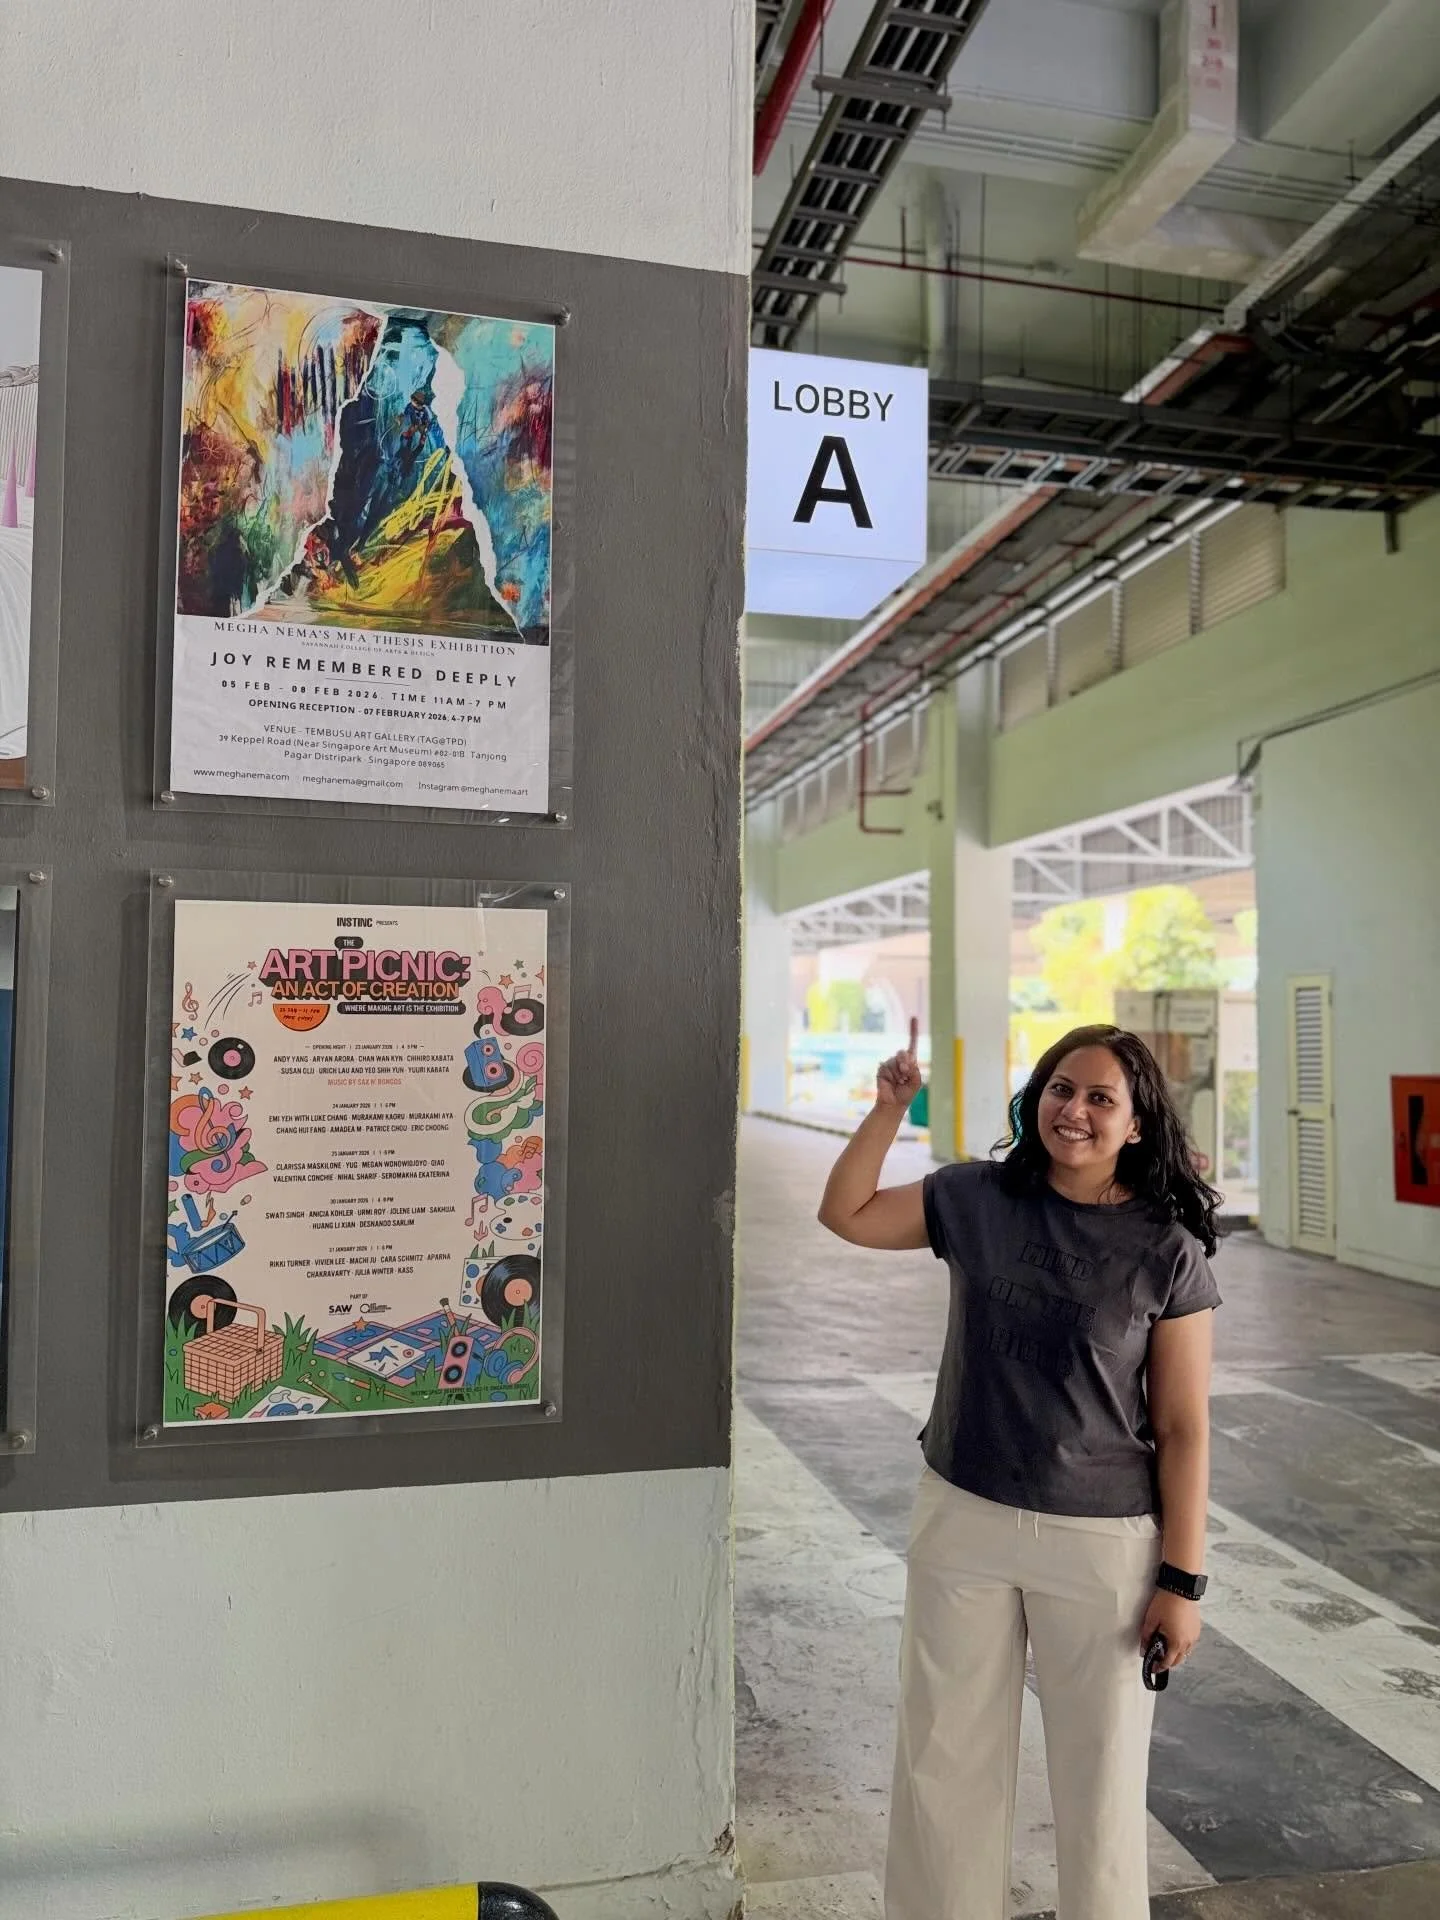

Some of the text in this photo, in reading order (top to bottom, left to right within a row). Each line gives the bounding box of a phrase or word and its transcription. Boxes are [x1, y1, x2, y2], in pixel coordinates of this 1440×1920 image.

[774, 380, 894, 423] LOBBY
[792, 434, 874, 530] A
[214, 621, 516, 656] MEGHA NEMA'S MFA THESIS EXHIBITION
[210, 650, 517, 688] JOY REMEMBERED DEEPLY
[222, 679, 236, 689] 05
[245, 681, 270, 691] FEB
[292, 684, 306, 694] 08
[315, 686, 340, 696] FEB
[392, 692, 426, 703] TIME
[488, 700, 506, 710] PM
[249, 698, 297, 710] OPENING
[299, 702, 355, 715] RECEPTION
[364, 707, 374, 716] 07
[376, 708, 426, 720] FEBRUARY
[467, 715, 481, 724] PM
[264, 724, 297, 735] VENUE
[305, 727, 352, 739] TEMBUSU
[354, 730, 372, 740] ART
[374, 731, 415, 744] GALLERY
[231, 734, 265, 746] Keppel
[267, 736, 291, 747] Road
[293, 738, 320, 749] (Near
[322, 740, 371, 753] Singapore
[373, 744, 387, 753] Art
[471, 751, 507, 763] Tanjong
[284, 750, 312, 761] Pagar
[315, 752, 362, 764] Distripark
[368, 755, 416, 768] Singapore
[418, 782, 459, 793] Instagram
[461, 785, 528, 796] @meghanemaart
[337, 916, 373, 928] INSTINC
[343, 939, 355, 947] THE
[259, 948, 472, 986] ART PICNIC:
[271, 981, 459, 999] AN ACT OF CREATION
[345, 1004, 459, 1013] WHERE MAKING ART IS THE EXHIBITION
[273, 1055, 290, 1063] ANDY
[292, 1055, 309, 1063] YANG
[312, 1055, 333, 1063] ARYAN
[334, 1055, 354, 1063] ARORA
[280, 1067, 301, 1075] SUSAN
[364, 1066, 376, 1074] YEO
[392, 1066, 404, 1074] YUN
[269, 1115, 280, 1123] EMI
[294, 1114, 309, 1122] WITH
[311, 1114, 326, 1122] LUKE
[327, 1114, 348, 1122] CHANG
[351, 1113, 384, 1121] MURAKAMI
[408, 1112, 440, 1120] MURAKAMI
[442, 1112, 454, 1120] AYA
[276, 1126, 297, 1135] CHANG
[309, 1126, 326, 1134] FANG
[330, 1125, 355, 1133] AMADEA
[356, 1125, 362, 1133] M
[365, 1125, 390, 1133] PATRICE
[411, 1124, 424, 1132] ERIC
[276, 1163, 306, 1171] CLARISSA
[273, 1174, 306, 1183] VALENTINA
[337, 1173, 354, 1181] NIHAL
[419, 1170, 450, 1179] EKATERINA
[265, 1212, 284, 1220] SWATI
[286, 1211, 305, 1219] SINGH
[330, 1209, 354, 1217] KOHLER
[412, 1206, 426, 1215] LIAM
[312, 1222, 333, 1230] HUANG
[341, 1221, 356, 1229] XIAN
[269, 1260, 286, 1268] RIKKI
[287, 1259, 311, 1267] TURNER
[315, 1258, 334, 1266] VIVIEN
[335, 1257, 346, 1266] LEE
[350, 1256, 368, 1265] MACHI
[380, 1255, 396, 1263] CARA
[398, 1254, 424, 1263] SCHMITZ
[427, 1253, 451, 1261] APARNA
[306, 1266, 414, 1279] CHAKRAVARTY JULIA WINTER KASS
[329, 1304, 352, 1314] SAW
